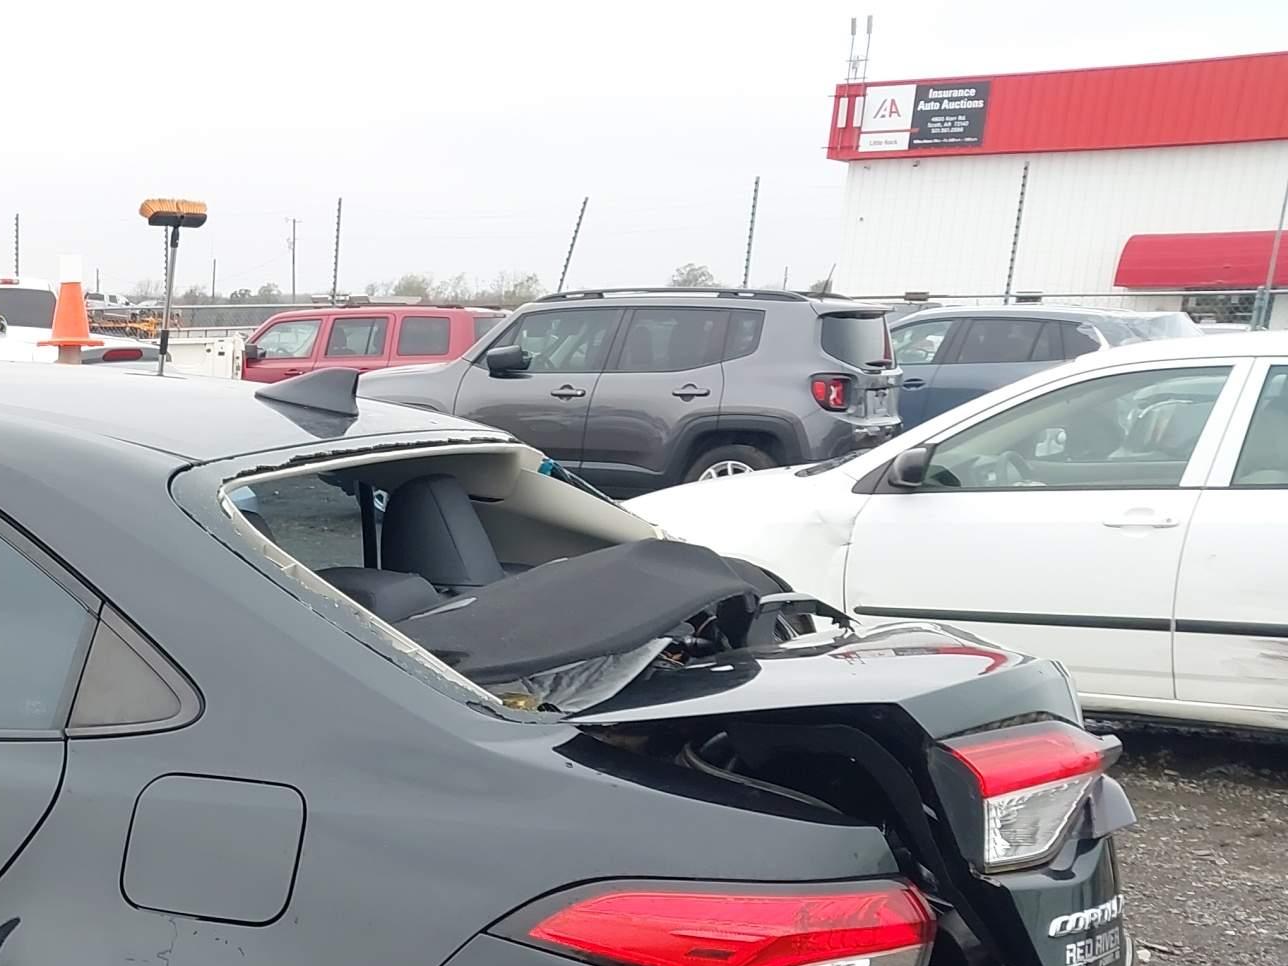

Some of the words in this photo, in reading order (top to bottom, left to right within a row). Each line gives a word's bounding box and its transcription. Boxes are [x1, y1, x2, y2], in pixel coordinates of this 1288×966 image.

[928, 88, 976, 99] Insurance
[917, 100, 940, 111] Auto
[941, 98, 984, 110] Auctions
[1065, 938, 1093, 965] RED
[1095, 926, 1120, 955] RIVER
